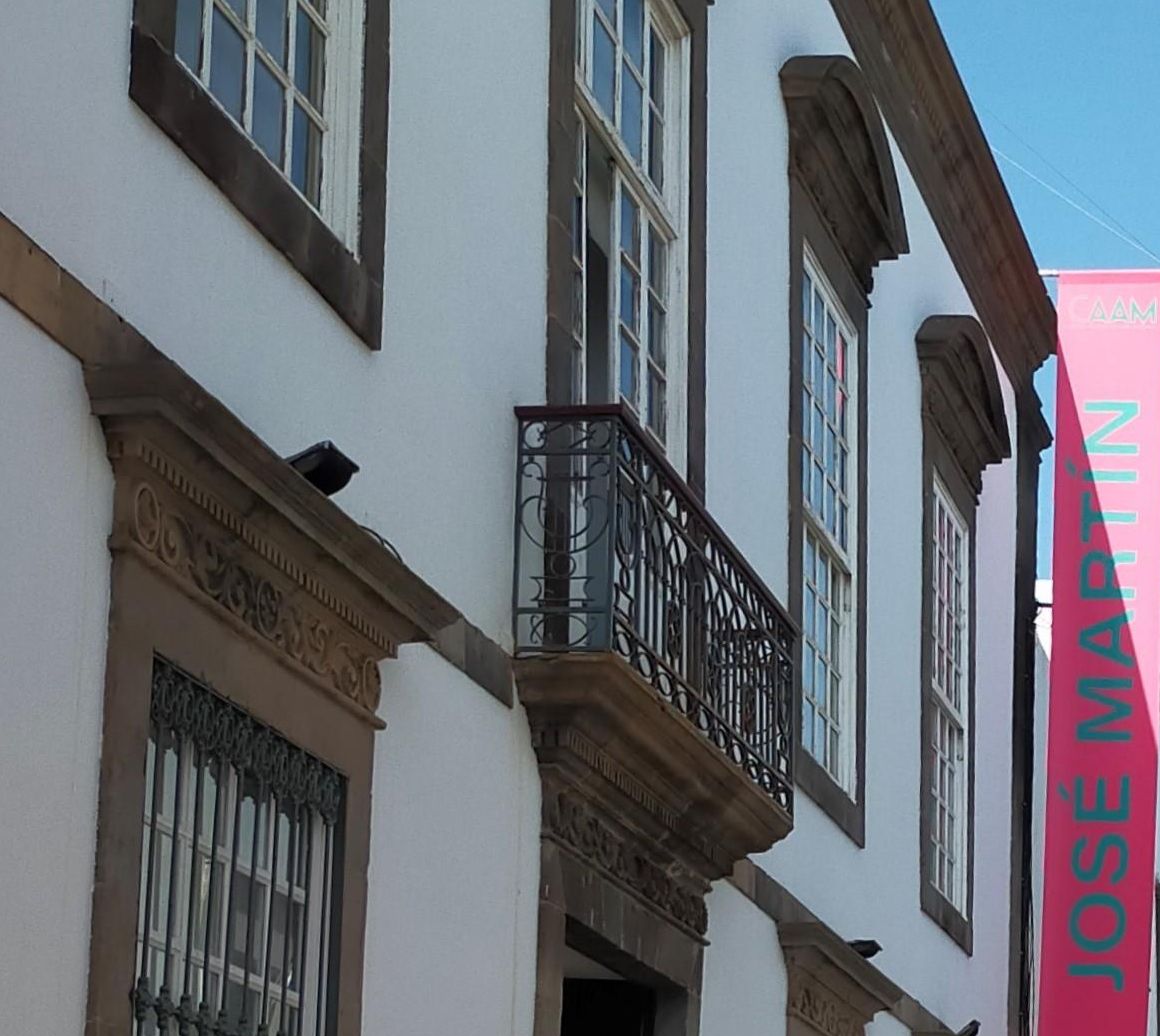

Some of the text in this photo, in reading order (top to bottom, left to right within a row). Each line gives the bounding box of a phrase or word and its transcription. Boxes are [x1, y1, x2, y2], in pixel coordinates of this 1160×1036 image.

[1067, 294, 1157, 324] CAAM
[1057, 400, 1141, 992] JOSÉ MARTÍN
